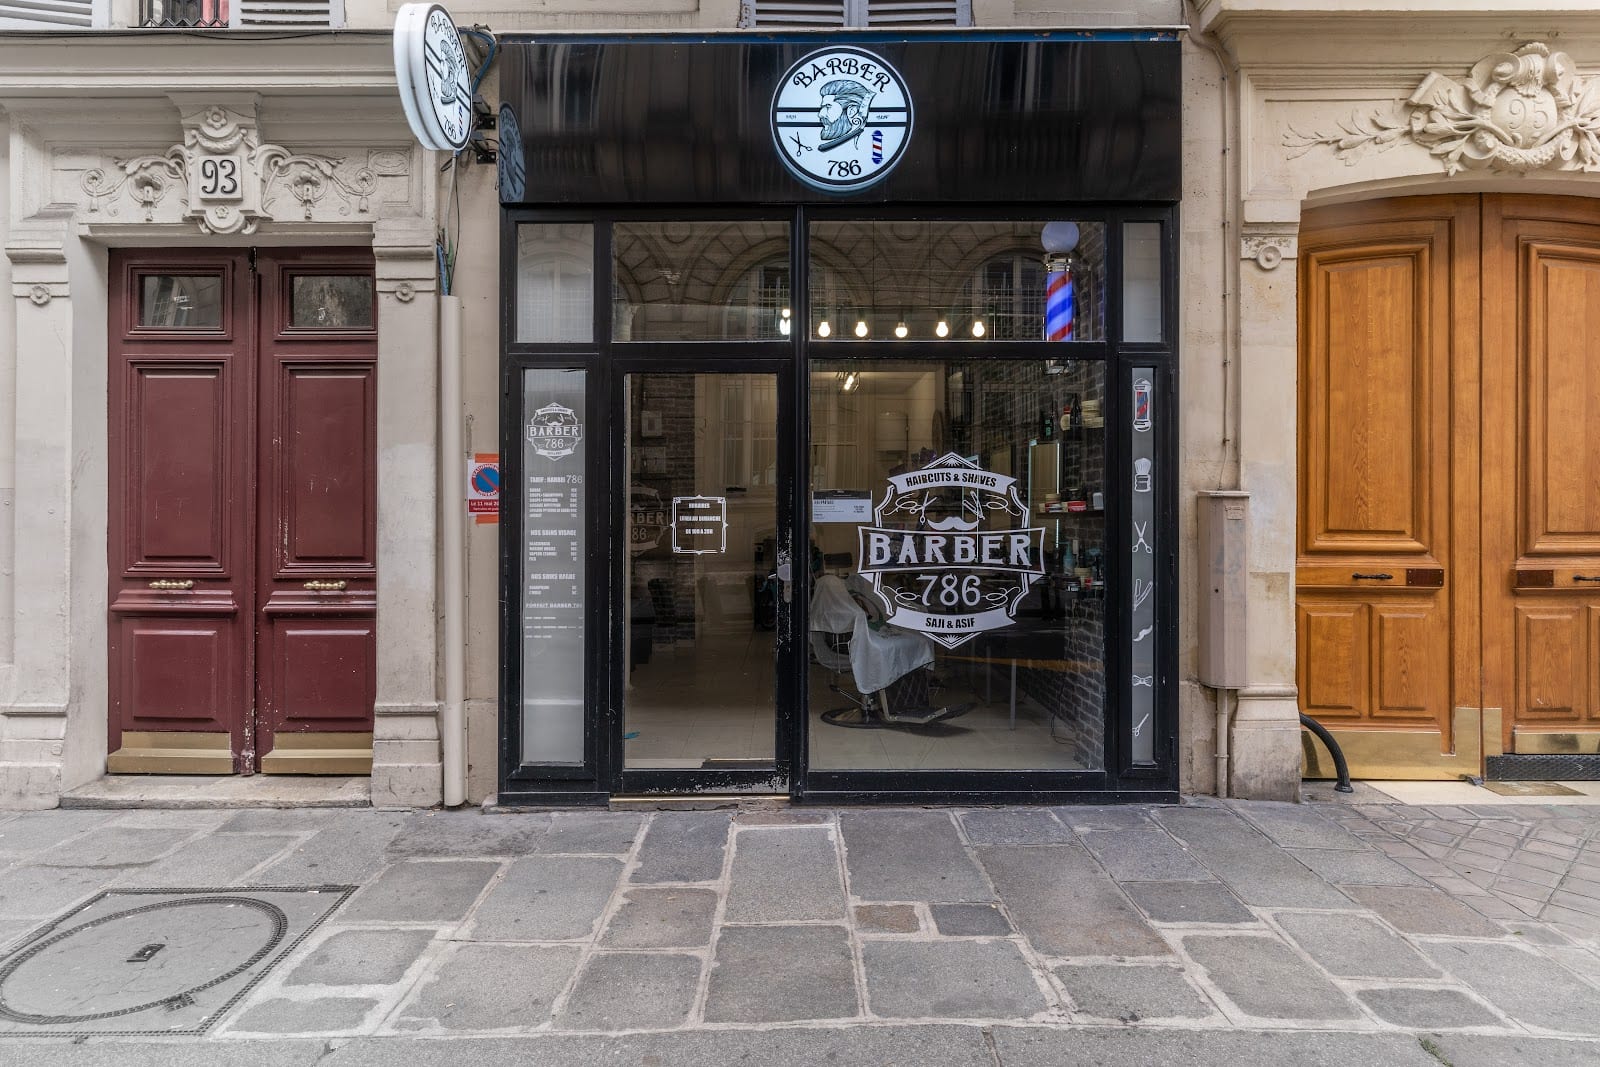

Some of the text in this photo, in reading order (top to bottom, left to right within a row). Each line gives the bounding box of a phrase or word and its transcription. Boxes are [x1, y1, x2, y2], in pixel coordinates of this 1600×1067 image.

[793, 57, 890, 93] BARBER
[1509, 99, 1549, 129] 95
[444, 115, 457, 140] 786
[202, 159, 238, 194] 93
[827, 159, 862, 177] 786
[529, 426, 579, 437] BARBER
[545, 438, 564, 449] 786
[905, 472, 997, 487] HAIRCUTS & SHAVES
[868, 532, 1032, 567] BARBER
[916, 573, 981, 606] 786
[925, 617, 976, 629] SAJI & ASIF
